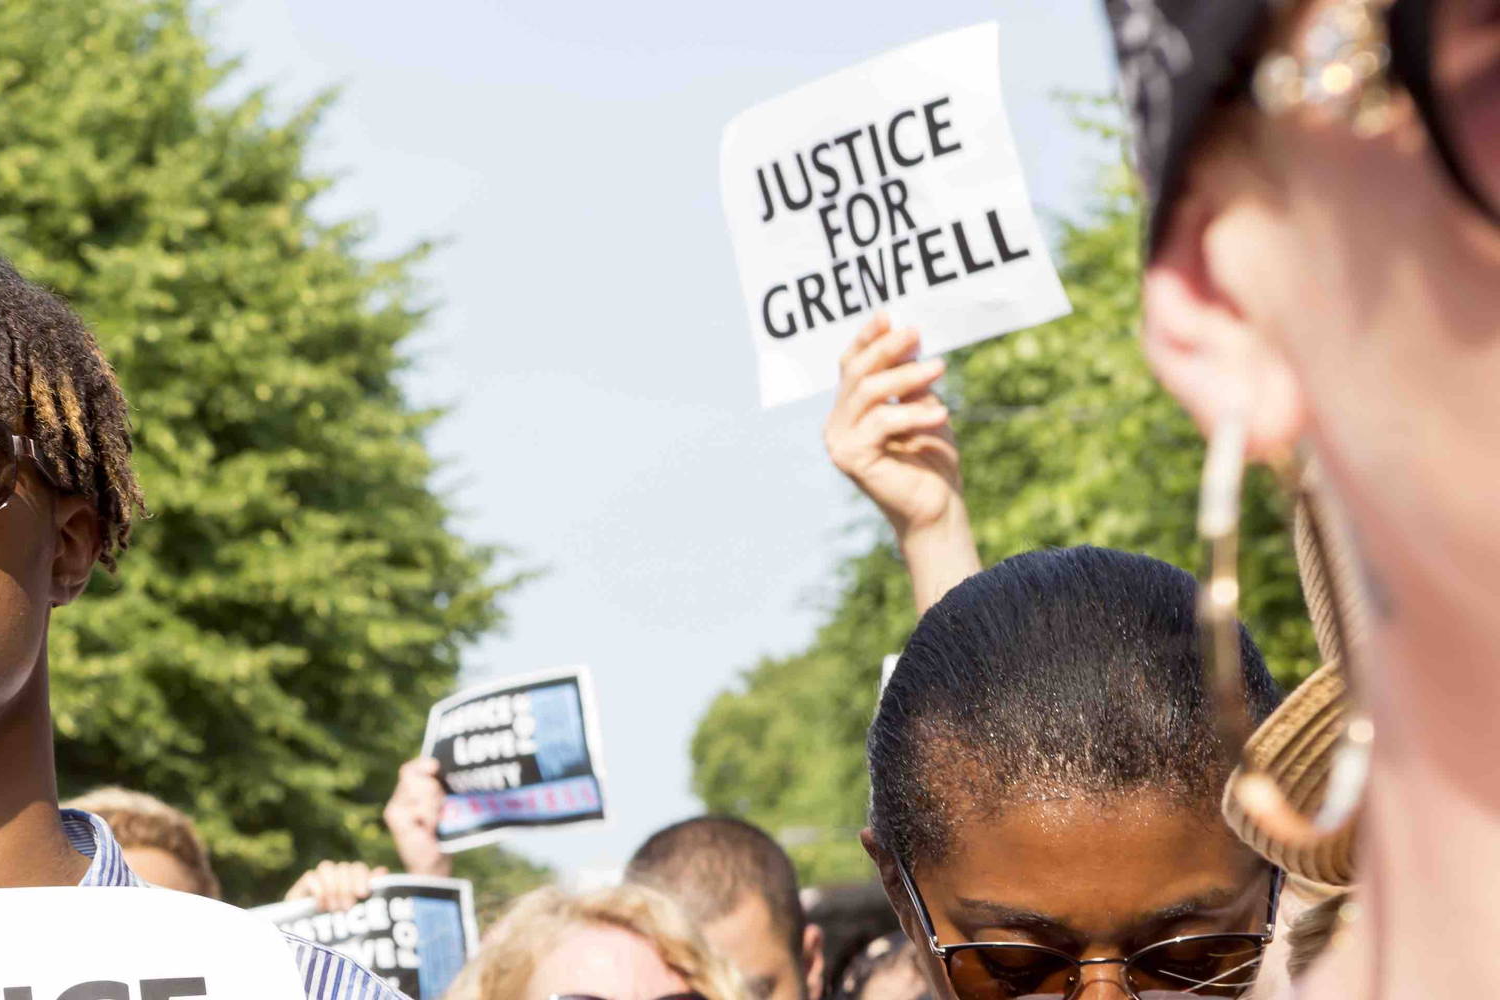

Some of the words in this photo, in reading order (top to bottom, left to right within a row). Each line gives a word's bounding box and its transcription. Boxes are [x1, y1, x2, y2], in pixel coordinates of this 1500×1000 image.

[756, 97, 962, 222] JUSTICE
[818, 178, 917, 259] FOR
[762, 210, 1030, 339] GRENFELL
